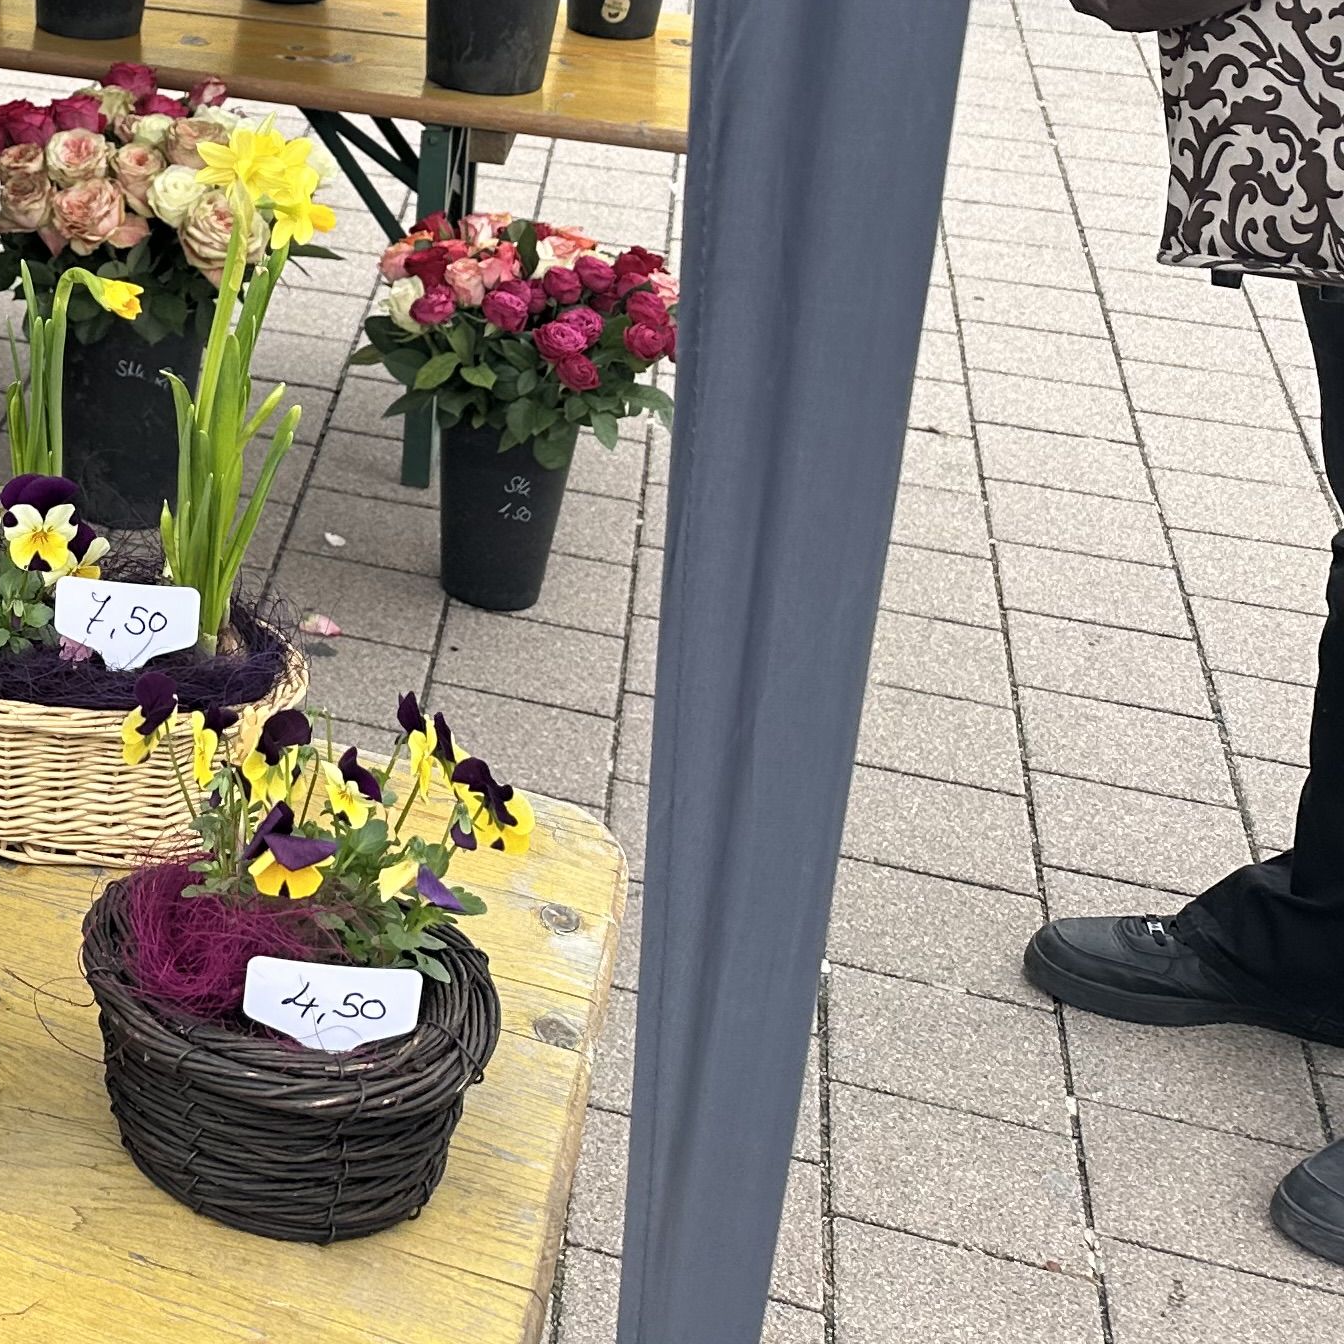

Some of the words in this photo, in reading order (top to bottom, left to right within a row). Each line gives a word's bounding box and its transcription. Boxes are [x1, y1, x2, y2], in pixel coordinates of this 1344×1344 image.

[497, 502, 532, 522] 1,50
[85, 591, 168, 640] 7,50
[280, 981, 387, 1025] 4,50
